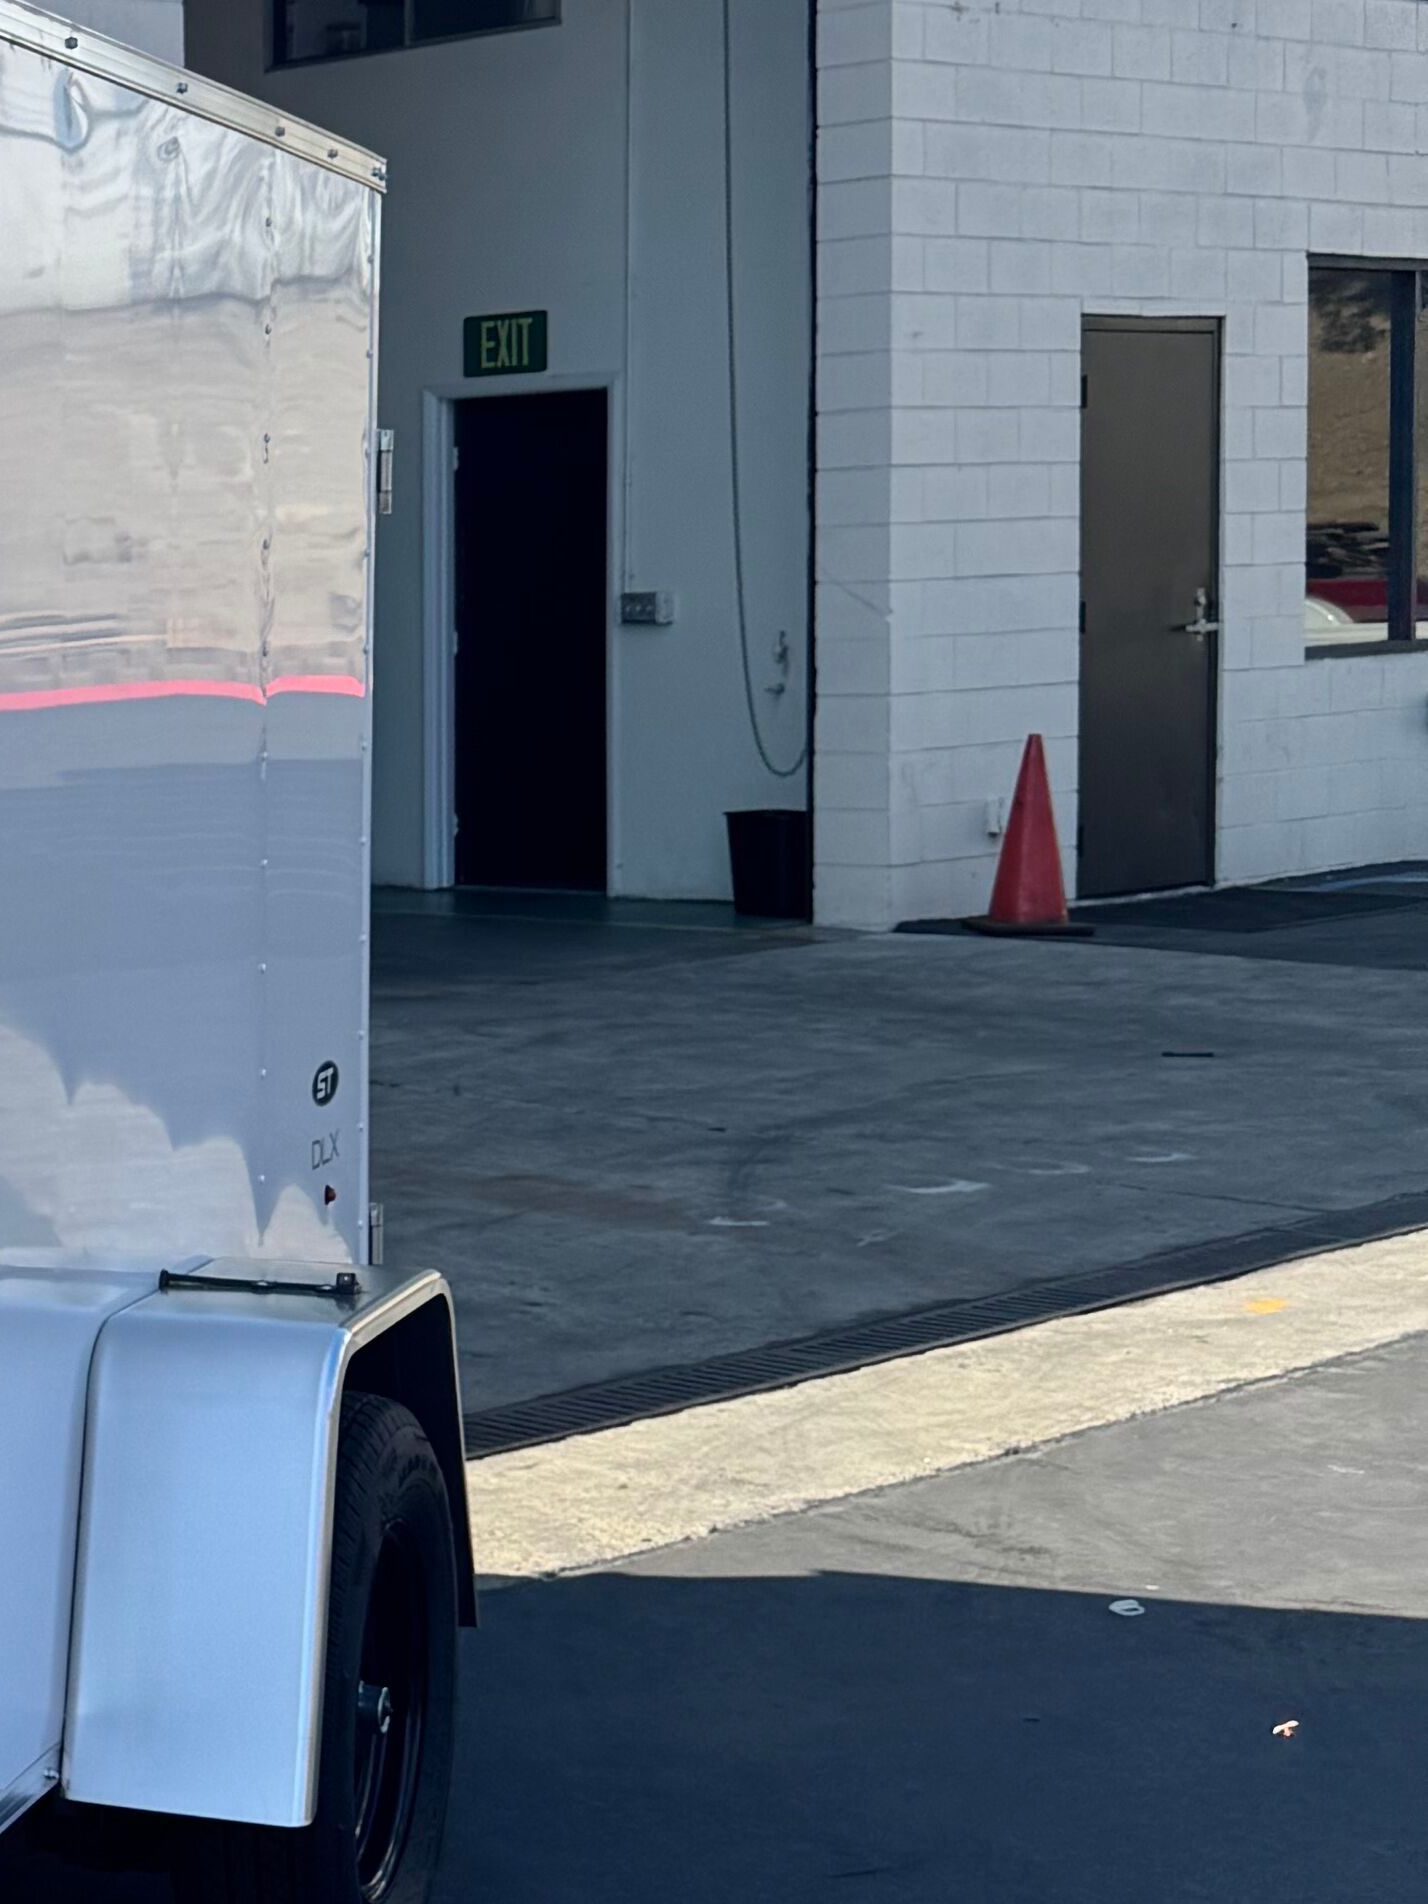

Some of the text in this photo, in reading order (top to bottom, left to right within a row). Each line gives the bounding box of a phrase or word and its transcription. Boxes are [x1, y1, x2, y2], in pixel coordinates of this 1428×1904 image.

[480, 317, 533, 369] EXIT
[315, 1066, 334, 1100] ST
[311, 1129, 340, 1170] DLX
